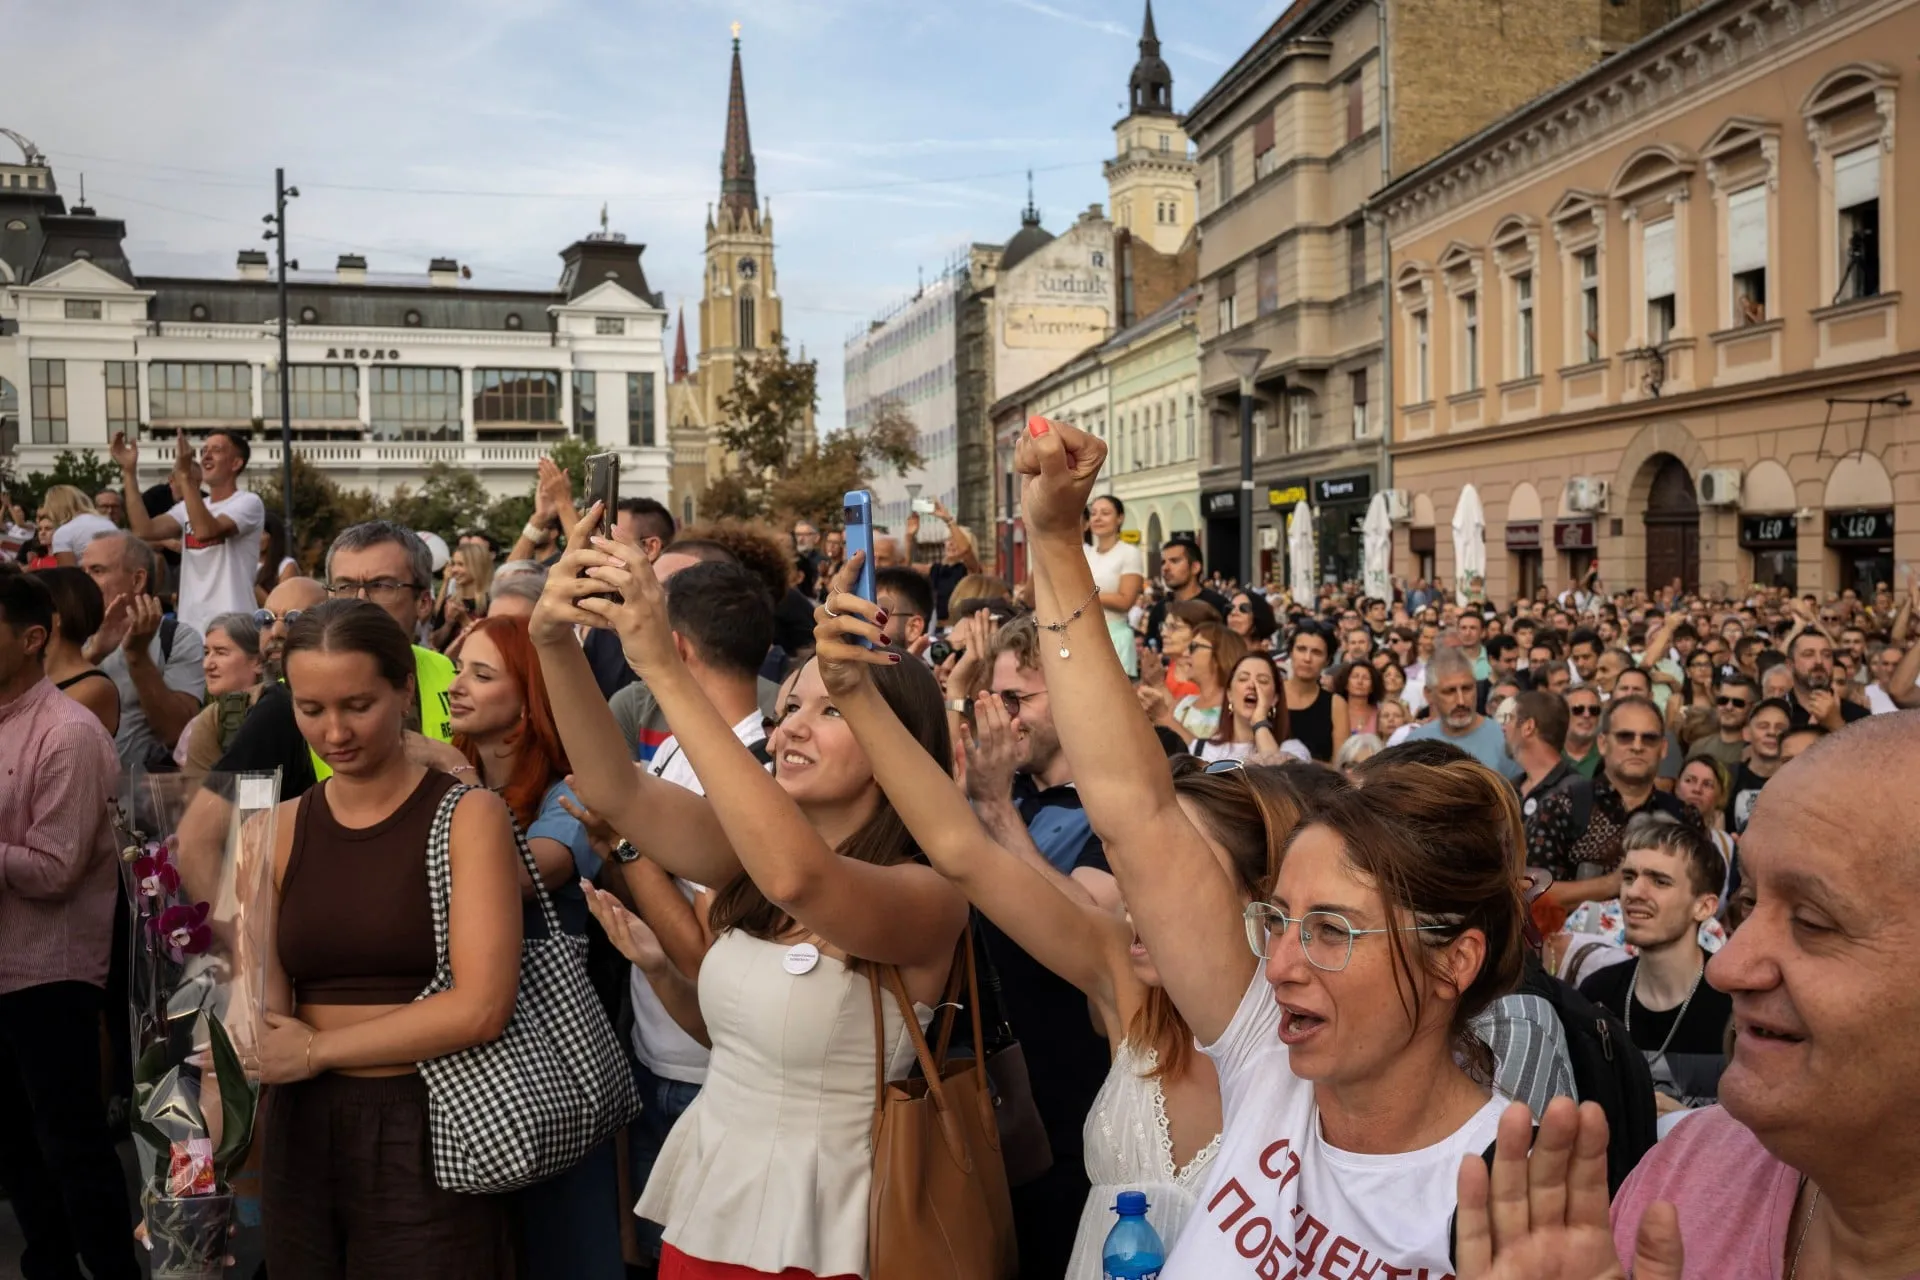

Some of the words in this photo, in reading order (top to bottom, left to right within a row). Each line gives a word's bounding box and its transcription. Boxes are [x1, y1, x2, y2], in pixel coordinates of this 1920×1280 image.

[1024, 313, 1086, 334] Arrow
[326, 347, 400, 361] АПОЛО
[1759, 520, 1783, 539] LEO
[1848, 516, 1876, 538] LEO
[1259, 1139, 1457, 1280] СТДЕН
[1207, 1177, 1298, 1280] ПОБ
